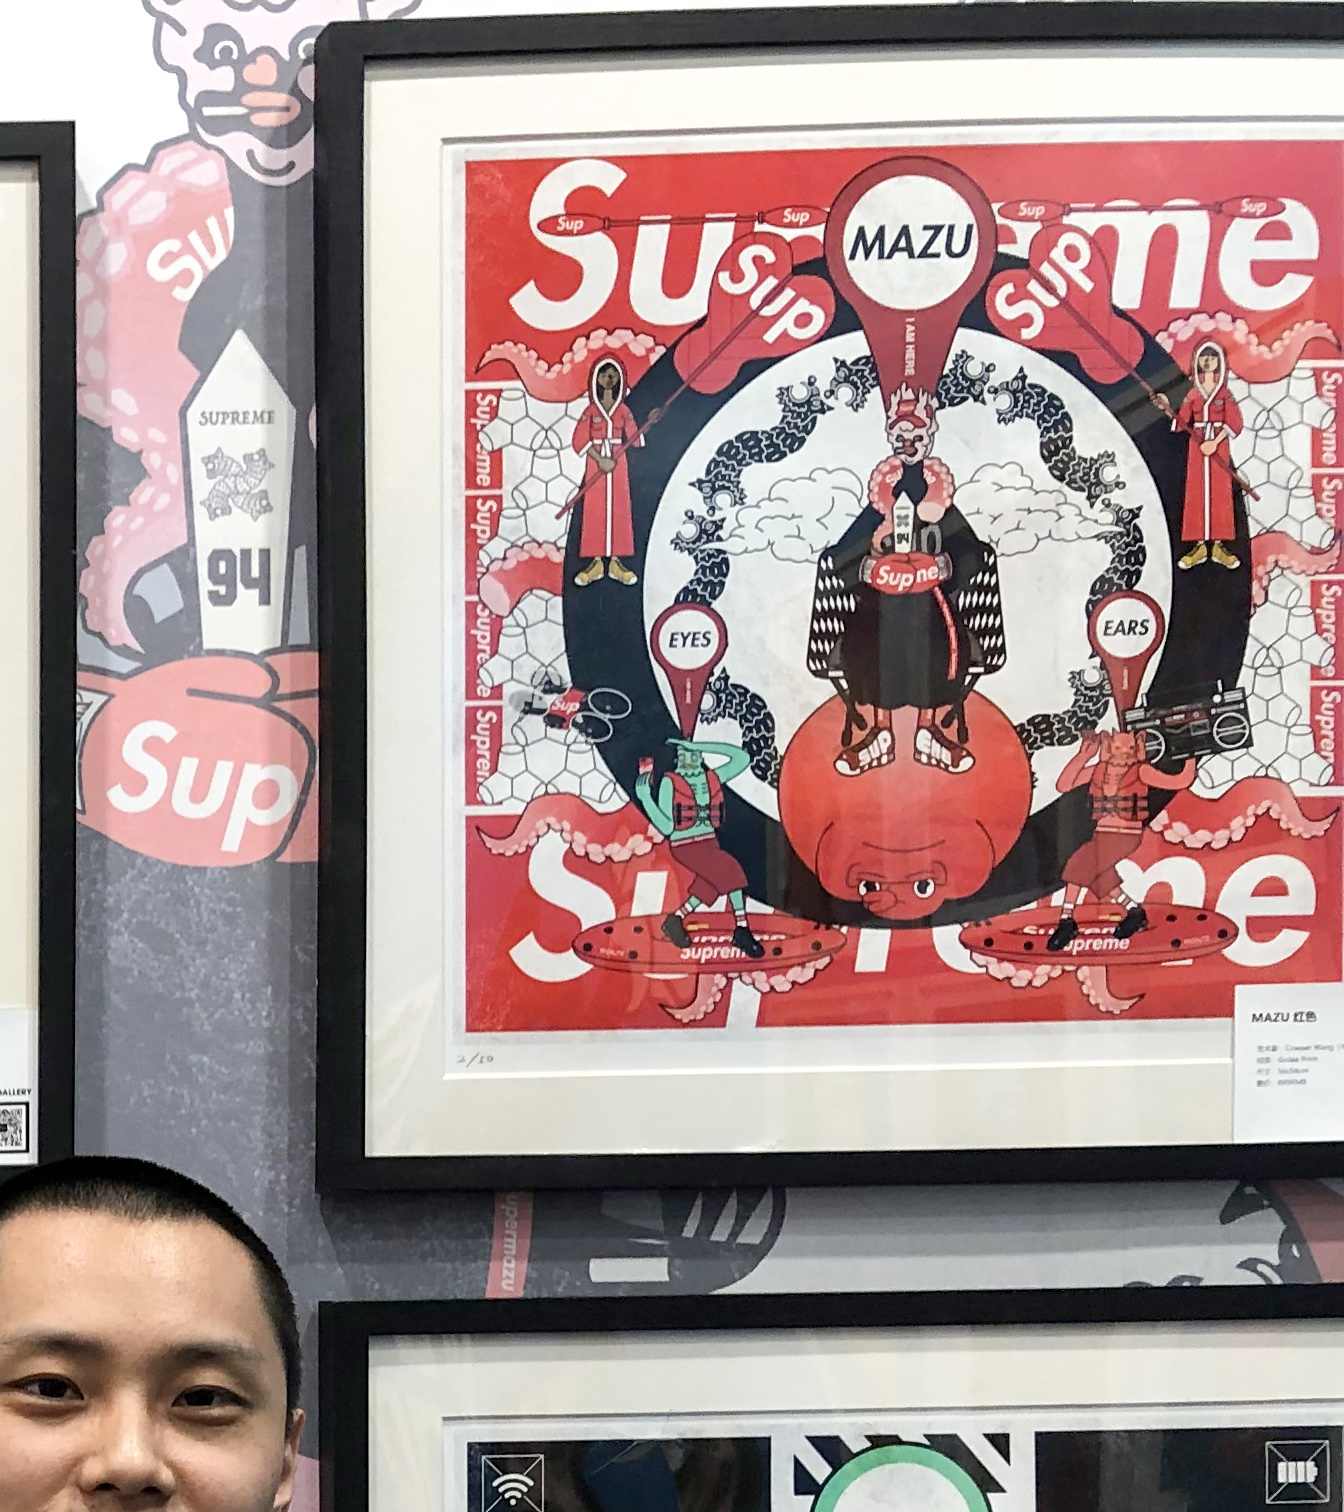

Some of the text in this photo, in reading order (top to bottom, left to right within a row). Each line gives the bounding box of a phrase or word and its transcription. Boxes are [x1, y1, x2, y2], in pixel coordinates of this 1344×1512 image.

[782, 208, 810, 225] Sup
[1018, 202, 1046, 219] Sup
[556, 216, 585, 233] Sup
[848, 223, 974, 261] MAZU
[994, 230, 1096, 340] Sup
[717, 244, 826, 345] Sup
[198, 409, 275, 427] SUPREME
[207, 547, 271, 608] 94
[876, 565, 914, 592] Sup
[1103, 618, 1149, 636] EARS
[668, 631, 712, 649] EYES
[106, 719, 299, 854] Sup
[1251, 1012, 1290, 1023] MAZU
